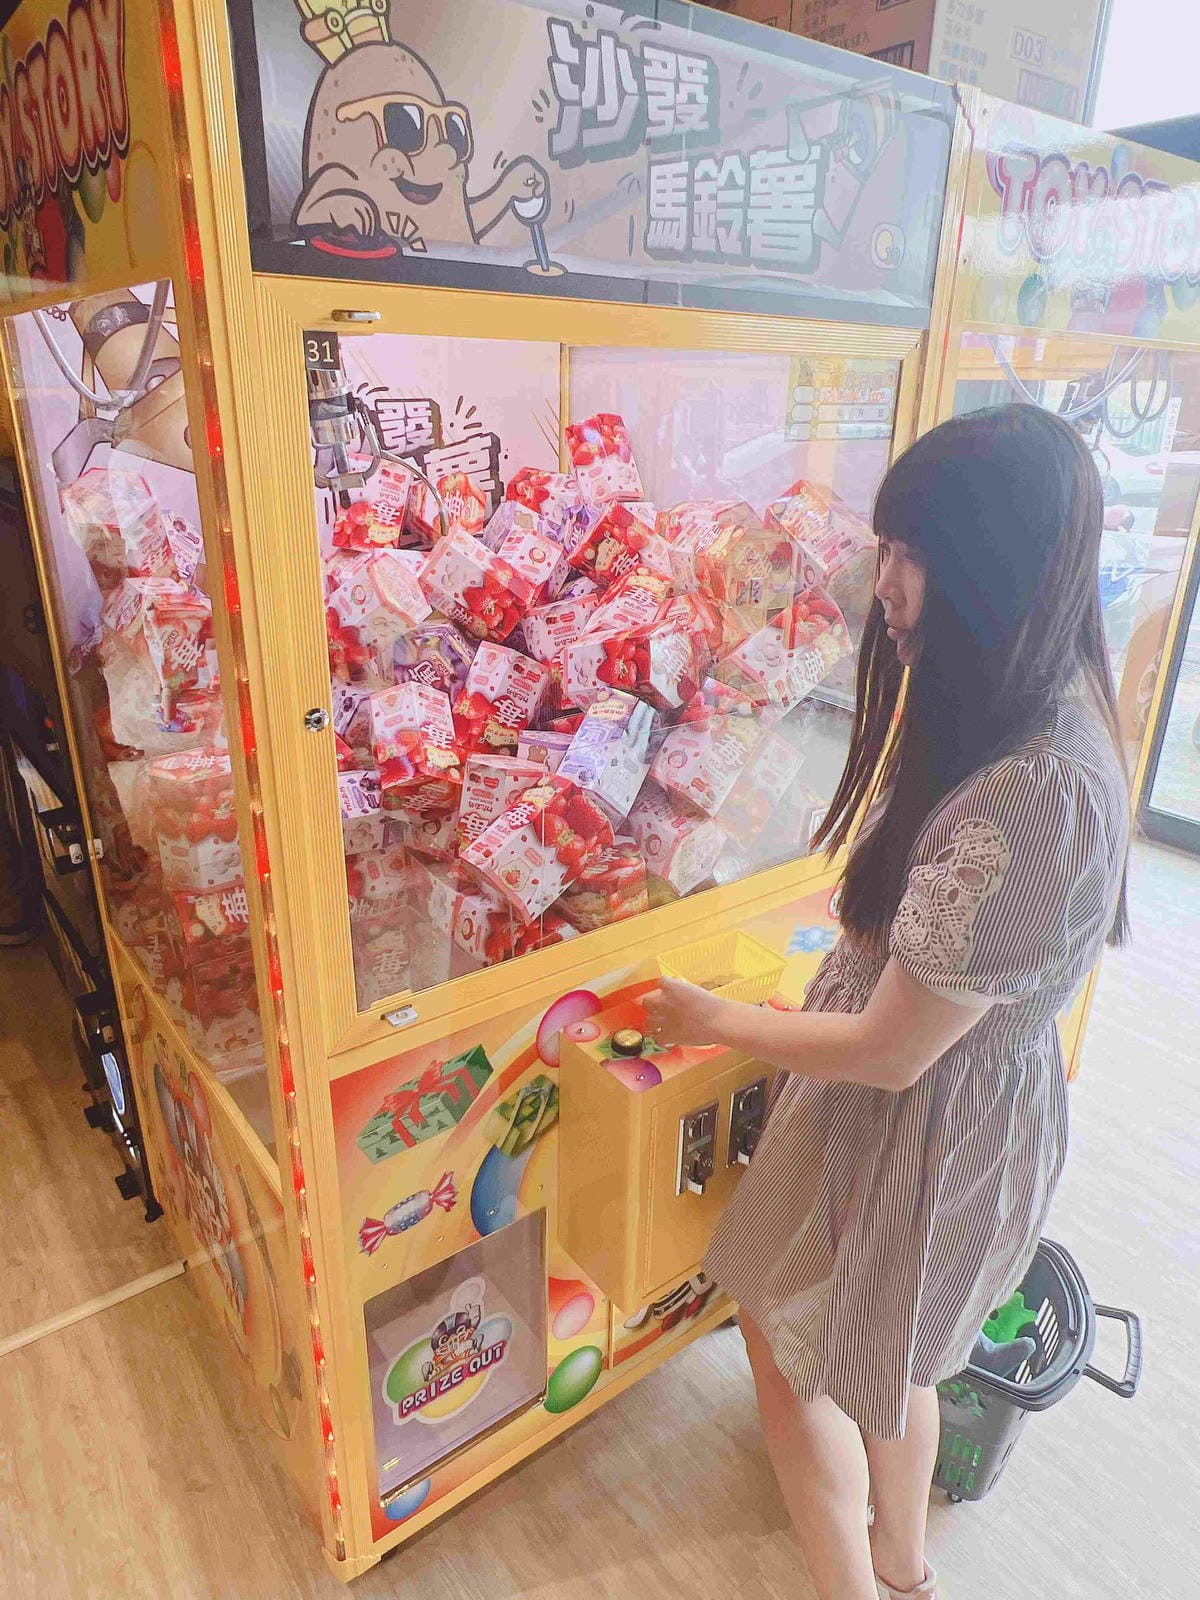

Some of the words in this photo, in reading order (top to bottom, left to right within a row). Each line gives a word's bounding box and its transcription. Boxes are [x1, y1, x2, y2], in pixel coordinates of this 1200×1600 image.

[549, 18, 714, 160] 沙發
[648, 146, 823, 264] 馬鈴薯
[986, 145, 1110, 264] TOY
[307, 339, 335, 363] 31
[400, 1366, 464, 1415] PRIZE
[466, 1341, 505, 1378] OUT
